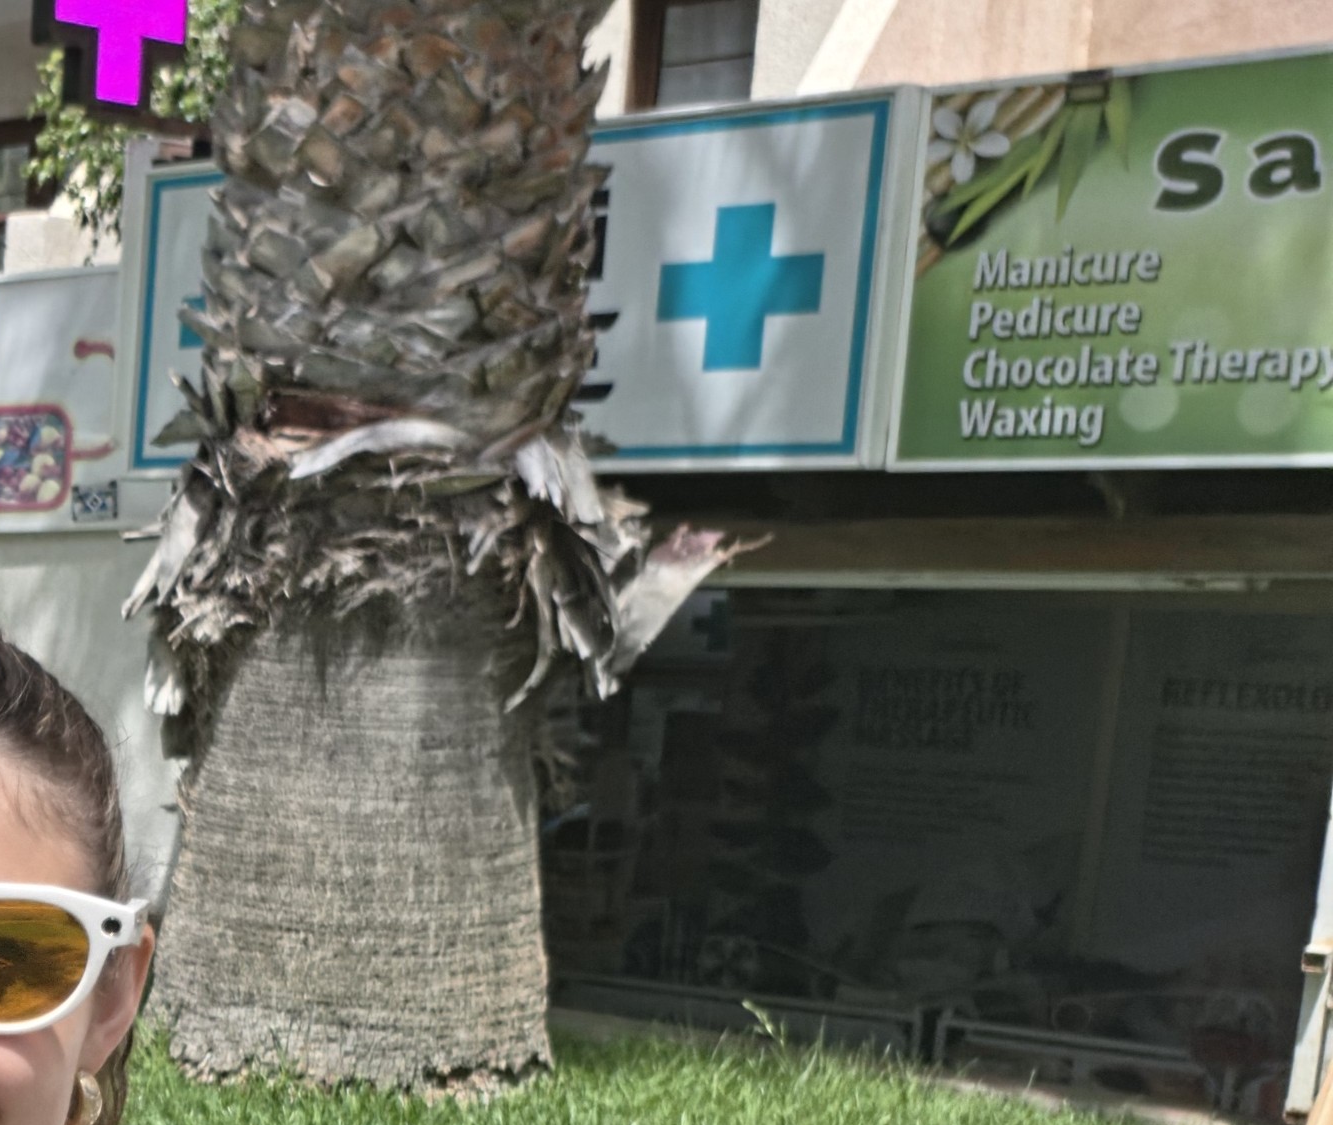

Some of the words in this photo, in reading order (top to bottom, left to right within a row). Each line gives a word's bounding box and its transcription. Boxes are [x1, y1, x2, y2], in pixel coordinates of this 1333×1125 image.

[972, 246, 1162, 290] Manicure
[968, 295, 1141, 340] Pedicure
[962, 345, 1158, 389] Chocolate
[959, 396, 1104, 446] Waxing
